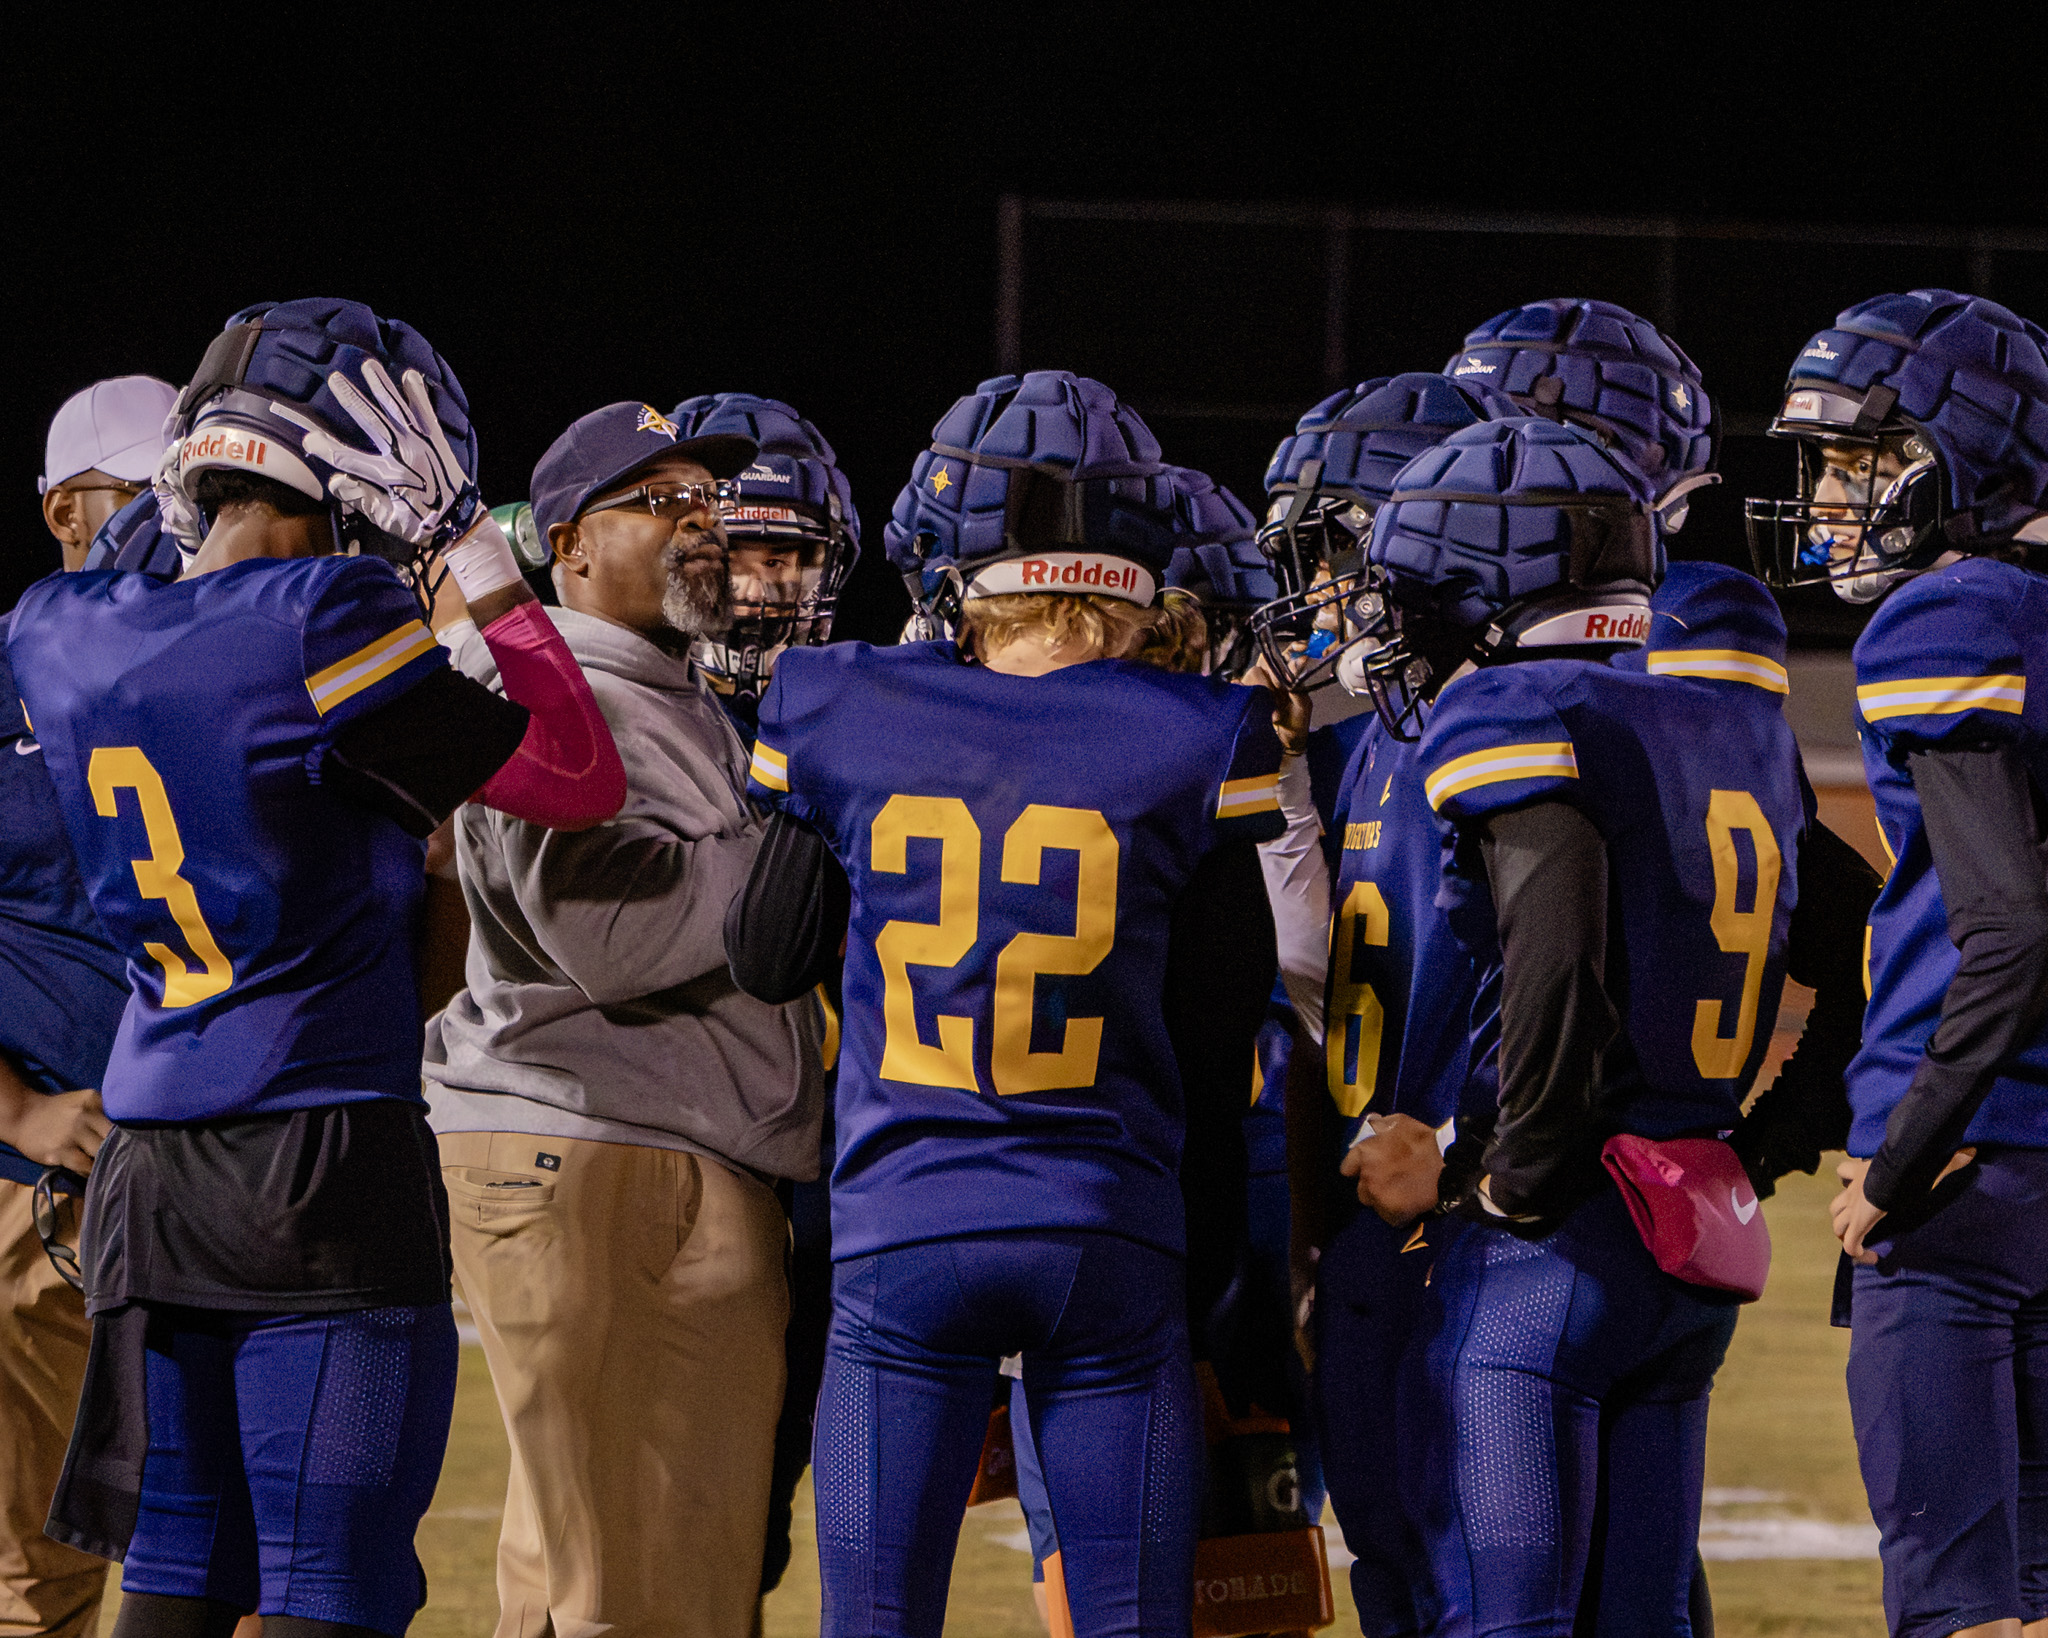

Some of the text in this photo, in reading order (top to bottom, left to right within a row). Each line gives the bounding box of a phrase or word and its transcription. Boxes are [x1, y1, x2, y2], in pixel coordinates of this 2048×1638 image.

[182, 434, 267, 468] Riddell
[735, 506, 790, 520] Riddell
[740, 472, 792, 484] GUARDIAN
[1021, 559, 1138, 593] Riddell
[87, 746, 233, 1008] 3
[870, 793, 1120, 1096] 22
[1691, 788, 1782, 1079] 9
[1326, 880, 1389, 1118] 6
